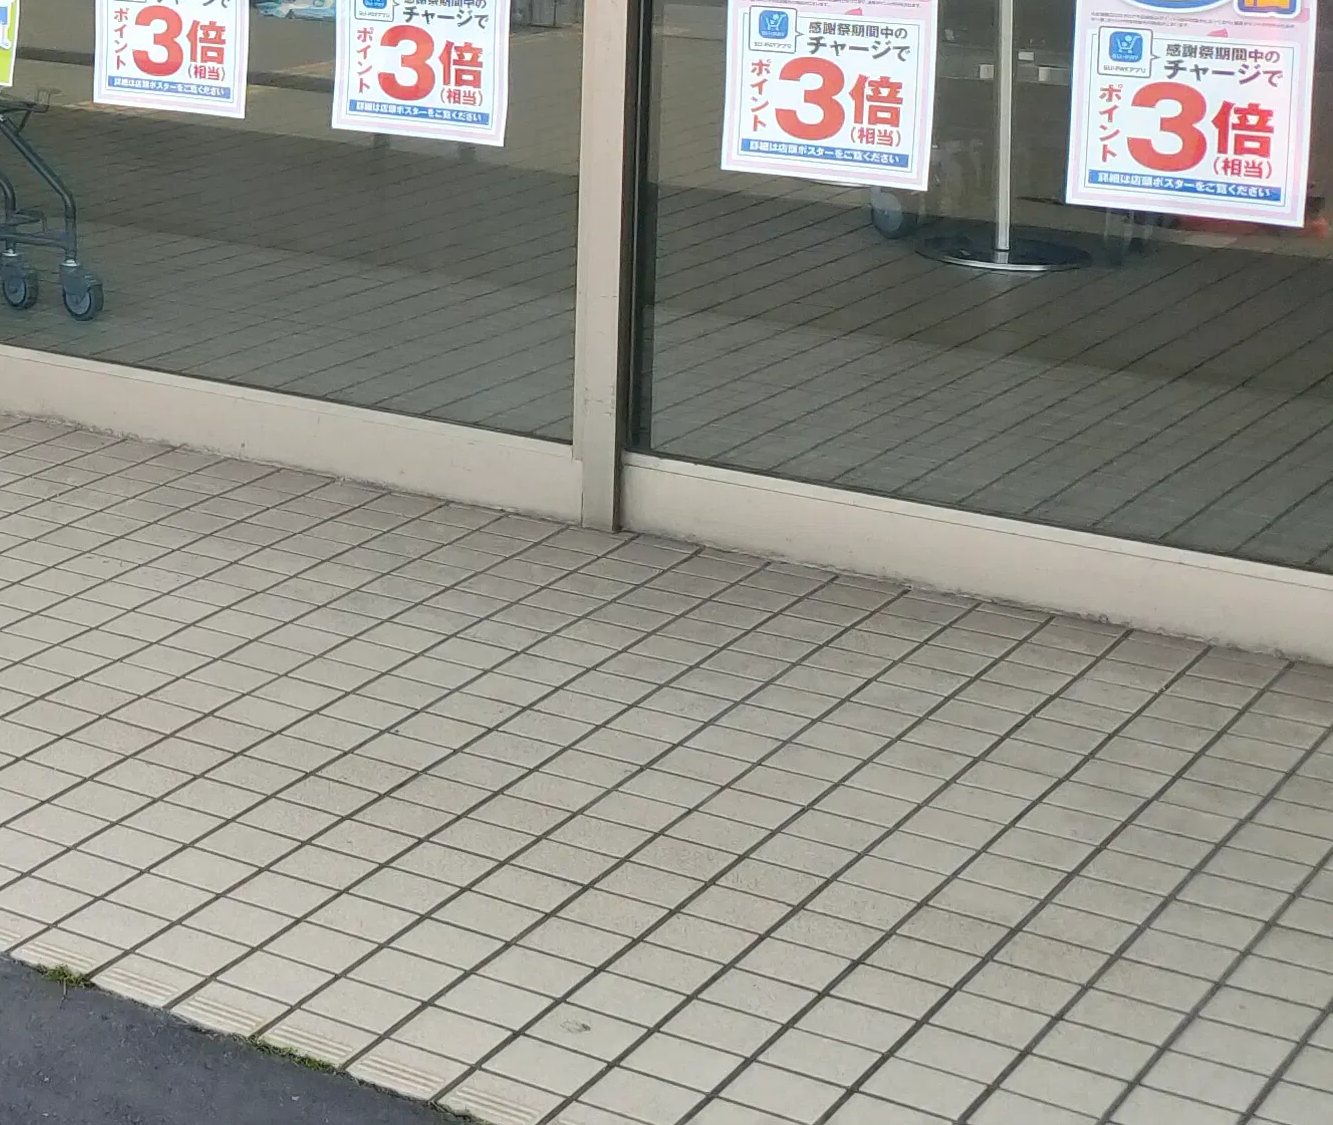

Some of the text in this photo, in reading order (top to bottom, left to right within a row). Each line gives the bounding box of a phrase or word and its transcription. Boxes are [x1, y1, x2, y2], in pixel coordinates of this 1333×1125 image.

[114, 7, 129, 70] ポイント
[403, 7, 488, 29] チャージで
[807, 36, 910, 62] チャージで
[357, 27, 373, 93] ポイント
[1164, 60, 1283, 88] チャージで
[751, 59, 771, 132] ポイント
[1099, 83, 1123, 162] ポイント
